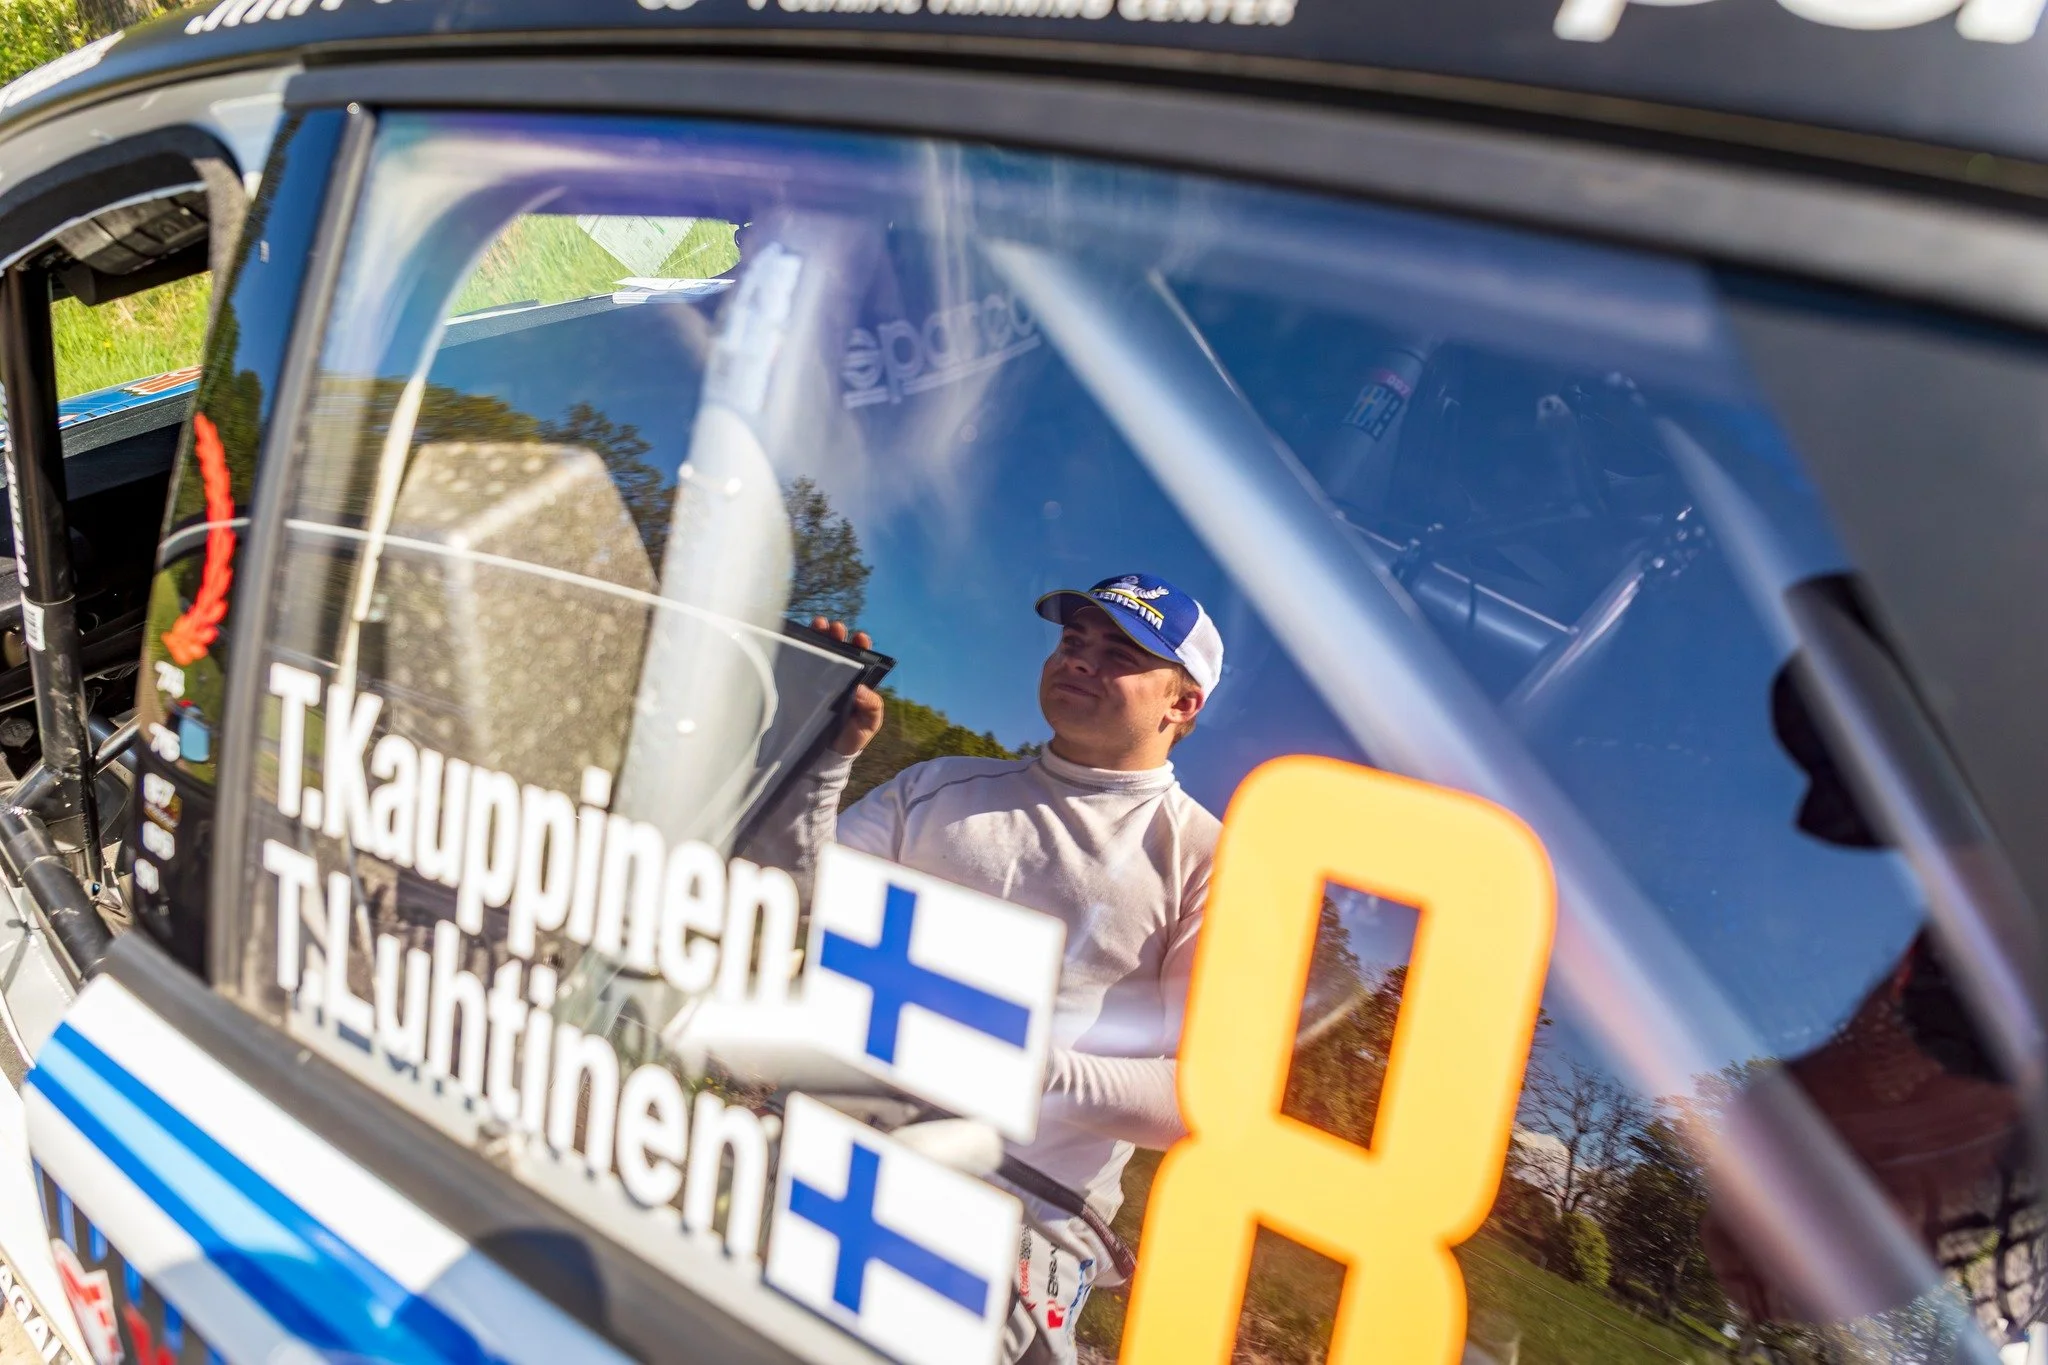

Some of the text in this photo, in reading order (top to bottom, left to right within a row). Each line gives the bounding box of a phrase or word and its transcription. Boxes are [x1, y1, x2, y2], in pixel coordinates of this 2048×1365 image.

[268, 662, 801, 1001] T.Kauppinen
[262, 838, 770, 1260] T.Luhtinen
[1120, 753, 1557, 1365] 8
